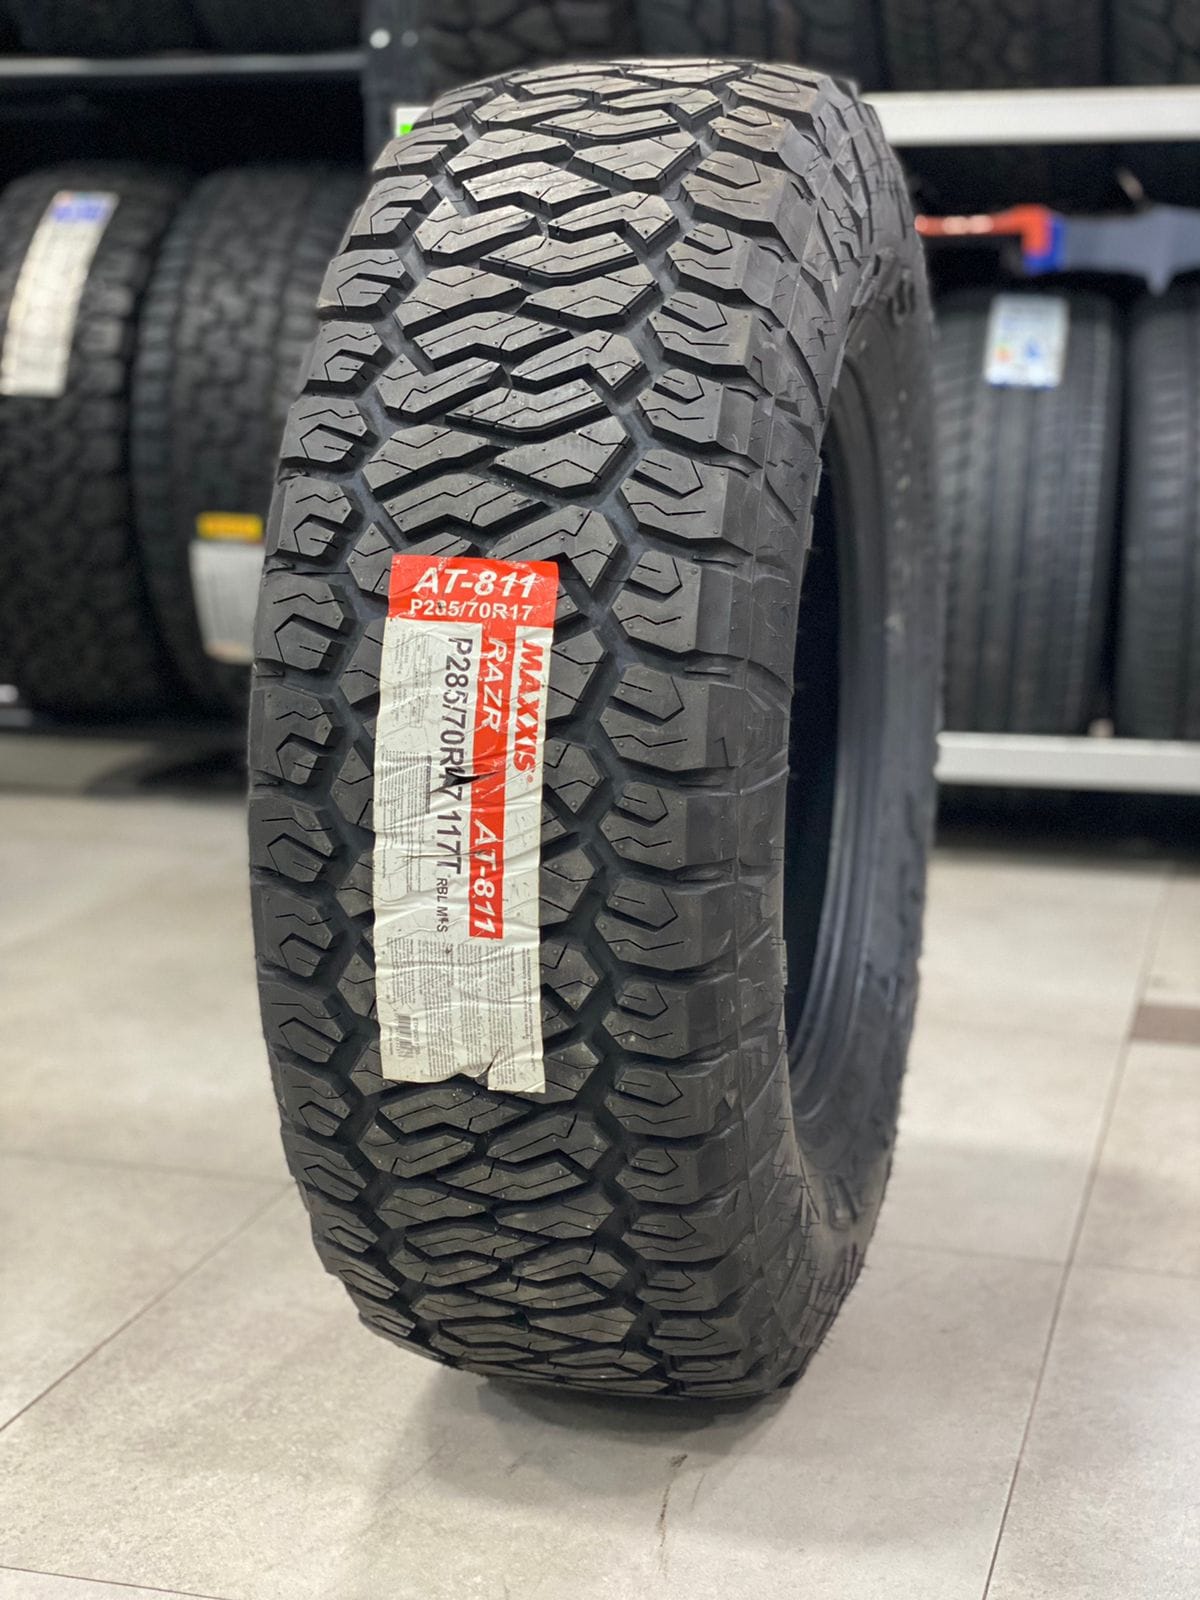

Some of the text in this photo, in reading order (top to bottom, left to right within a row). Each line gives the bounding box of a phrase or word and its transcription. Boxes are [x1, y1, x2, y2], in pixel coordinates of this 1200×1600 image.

[412, 567, 537, 598] AT-811
[410, 599, 534, 621] P285/70R17
[473, 637, 508, 933] RAZR AT-811
[437, 810, 462, 874] 117T
[436, 878, 449, 902] RBL
